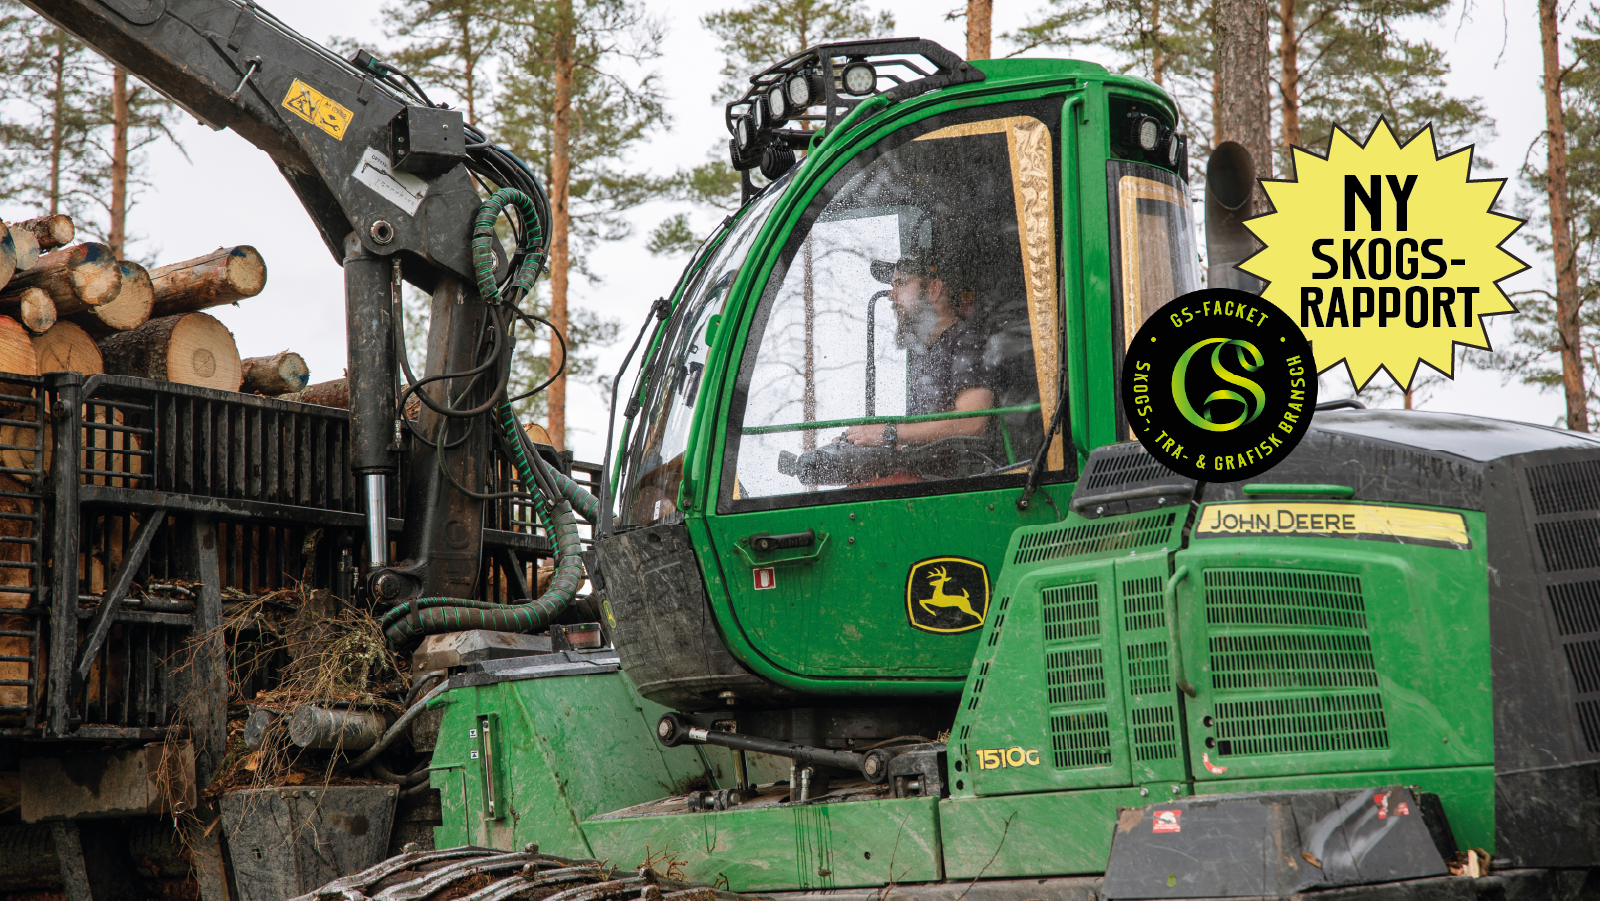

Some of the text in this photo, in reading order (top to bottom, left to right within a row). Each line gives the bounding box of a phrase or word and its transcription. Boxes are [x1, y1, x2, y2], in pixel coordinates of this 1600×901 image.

[1211, 510, 1356, 530] JOHN DEERE
[975, 746, 1040, 771] 1510G
